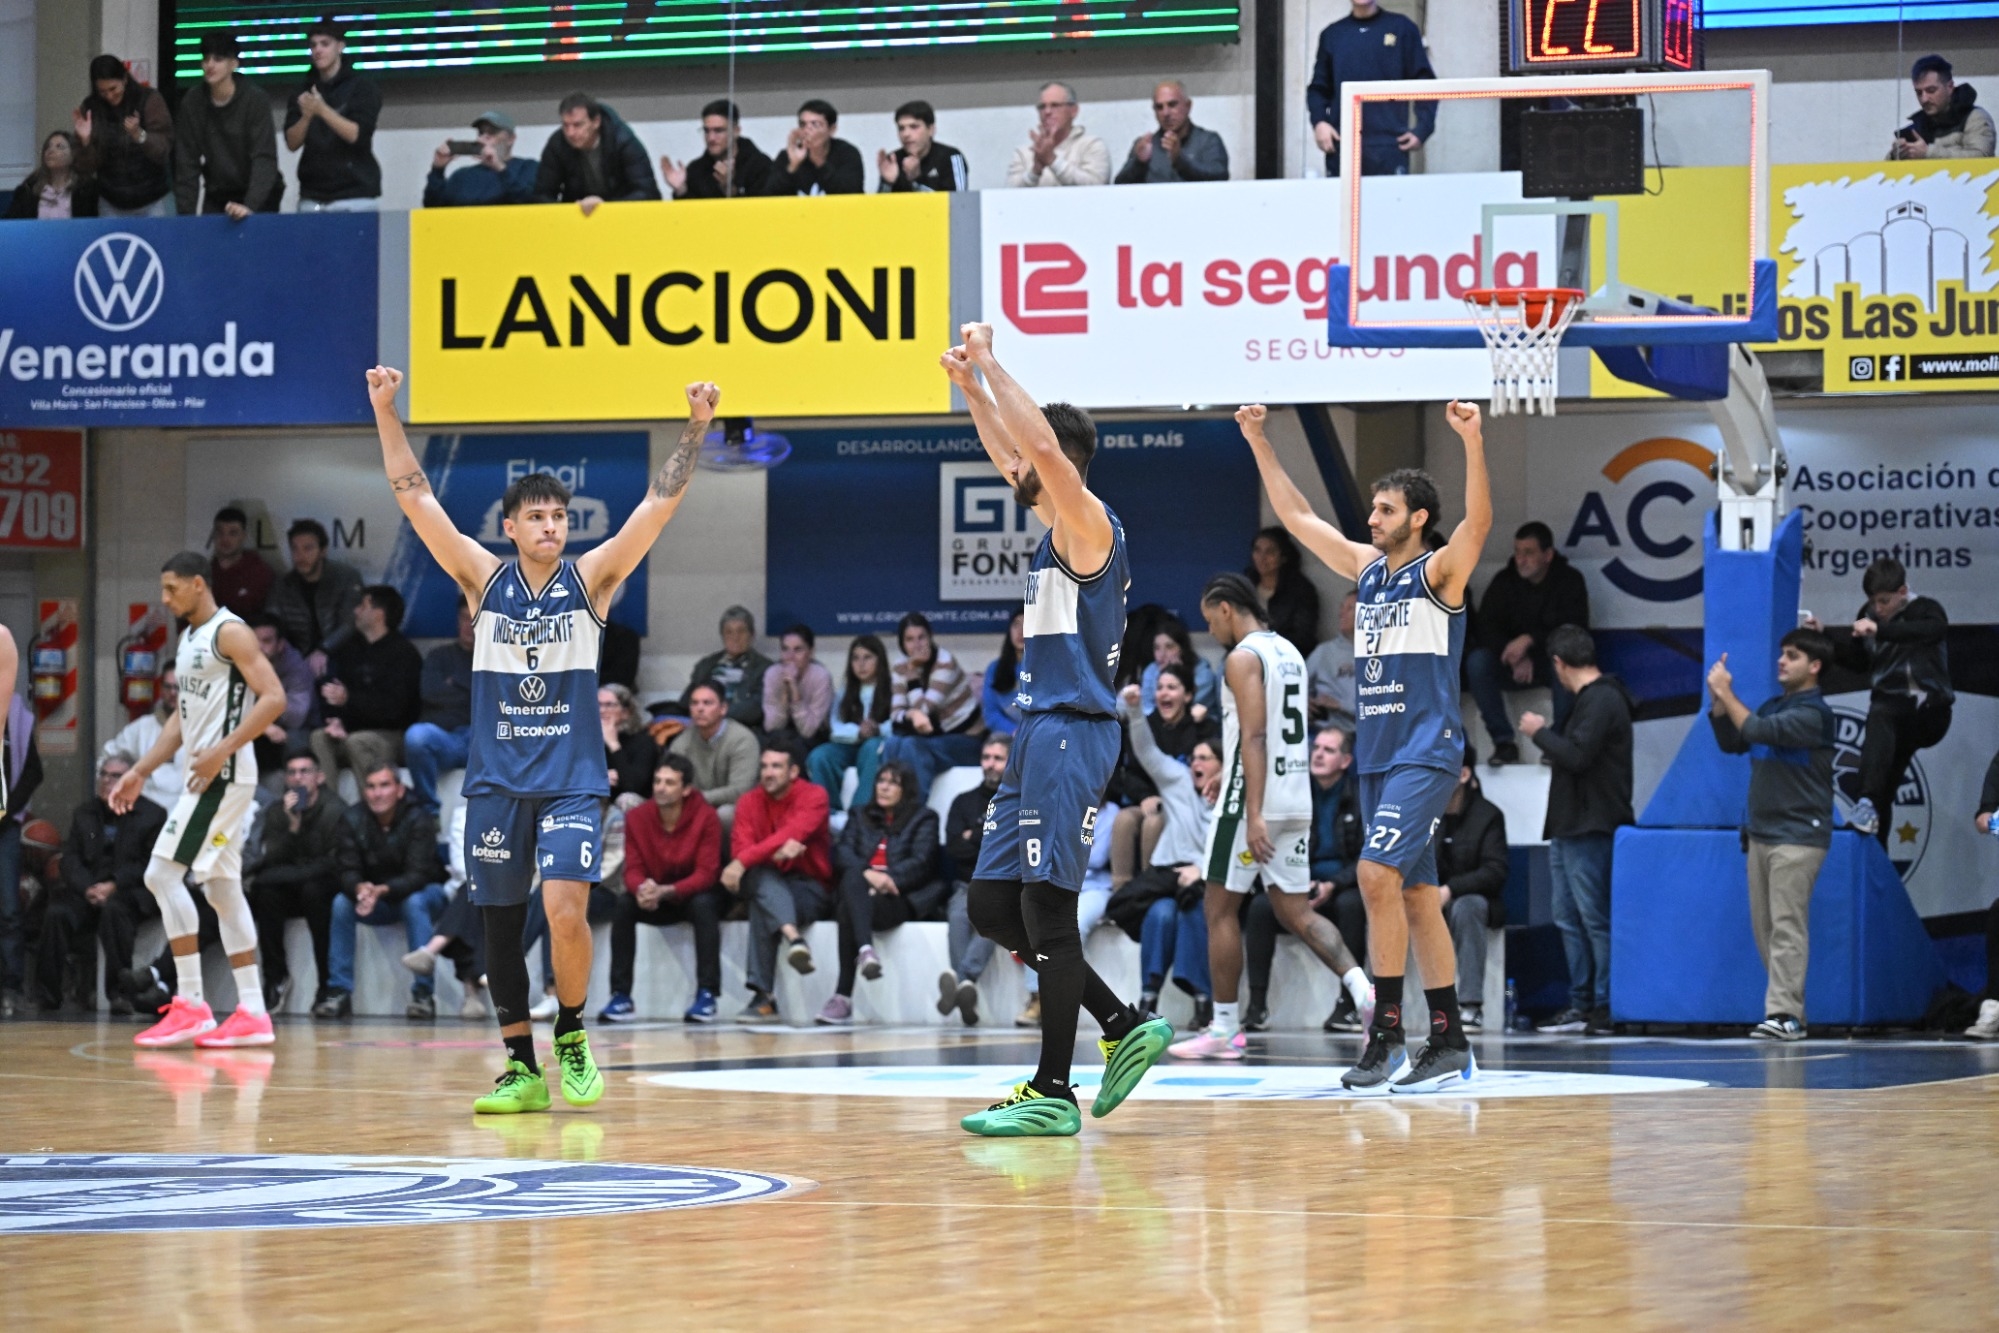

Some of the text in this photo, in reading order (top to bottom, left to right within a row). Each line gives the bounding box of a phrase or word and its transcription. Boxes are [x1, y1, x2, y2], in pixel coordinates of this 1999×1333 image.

[1117, 234, 1538, 319] la segunda
[441, 267, 915, 350] LANCIONI
[1842, 291, 1918, 339] Las
[62, 383, 172, 397] Concesionario oficial
[837, 438, 984, 455] DESARROLLANDO
[1103, 429, 1184, 449] DEL PAÍS
[1792, 462, 1976, 492] Asociación
[0, 490, 76, 541] 709
[952, 537, 1037, 552] GRUP
[952, 552, 1036, 576] FONT
[526, 646, 539, 671] 6
[499, 700, 570, 715] Veneranda
[1282, 684, 1304, 745] 5
[513, 724, 571, 737] ECONOVO
[1369, 825, 1401, 852] 27
[580, 840, 593, 868] 6
[1026, 838, 1041, 867] 8
